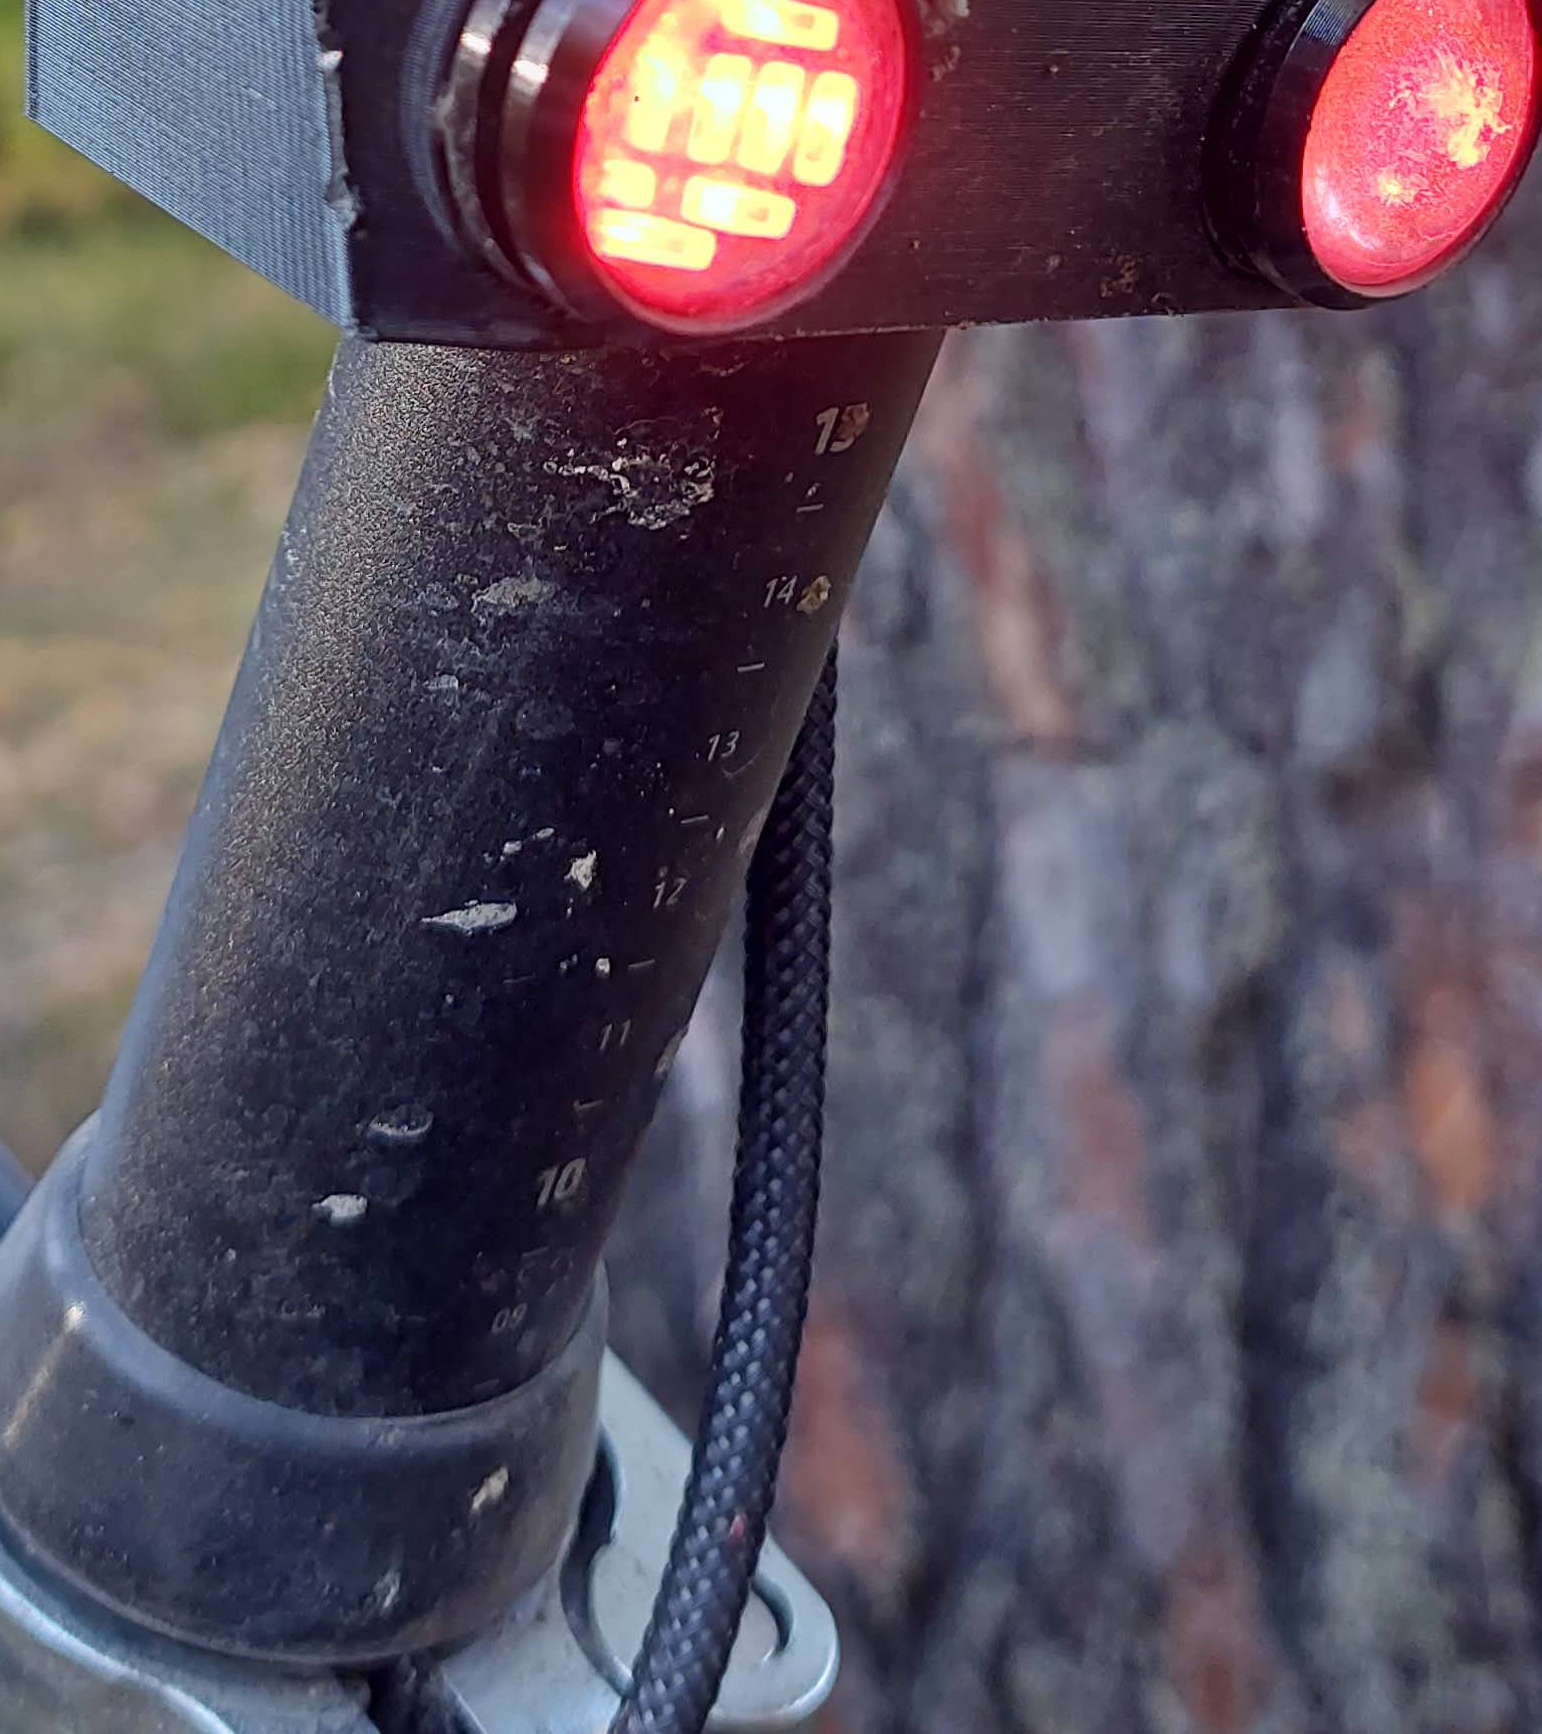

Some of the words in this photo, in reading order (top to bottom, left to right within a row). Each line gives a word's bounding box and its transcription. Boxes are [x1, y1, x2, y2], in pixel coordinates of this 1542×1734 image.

[764, 575, 797, 608] 14
[708, 730, 739, 760] 13
[653, 878, 686, 908] 12
[600, 1019, 631, 1051] 11
[537, 1158, 586, 1206] 10
